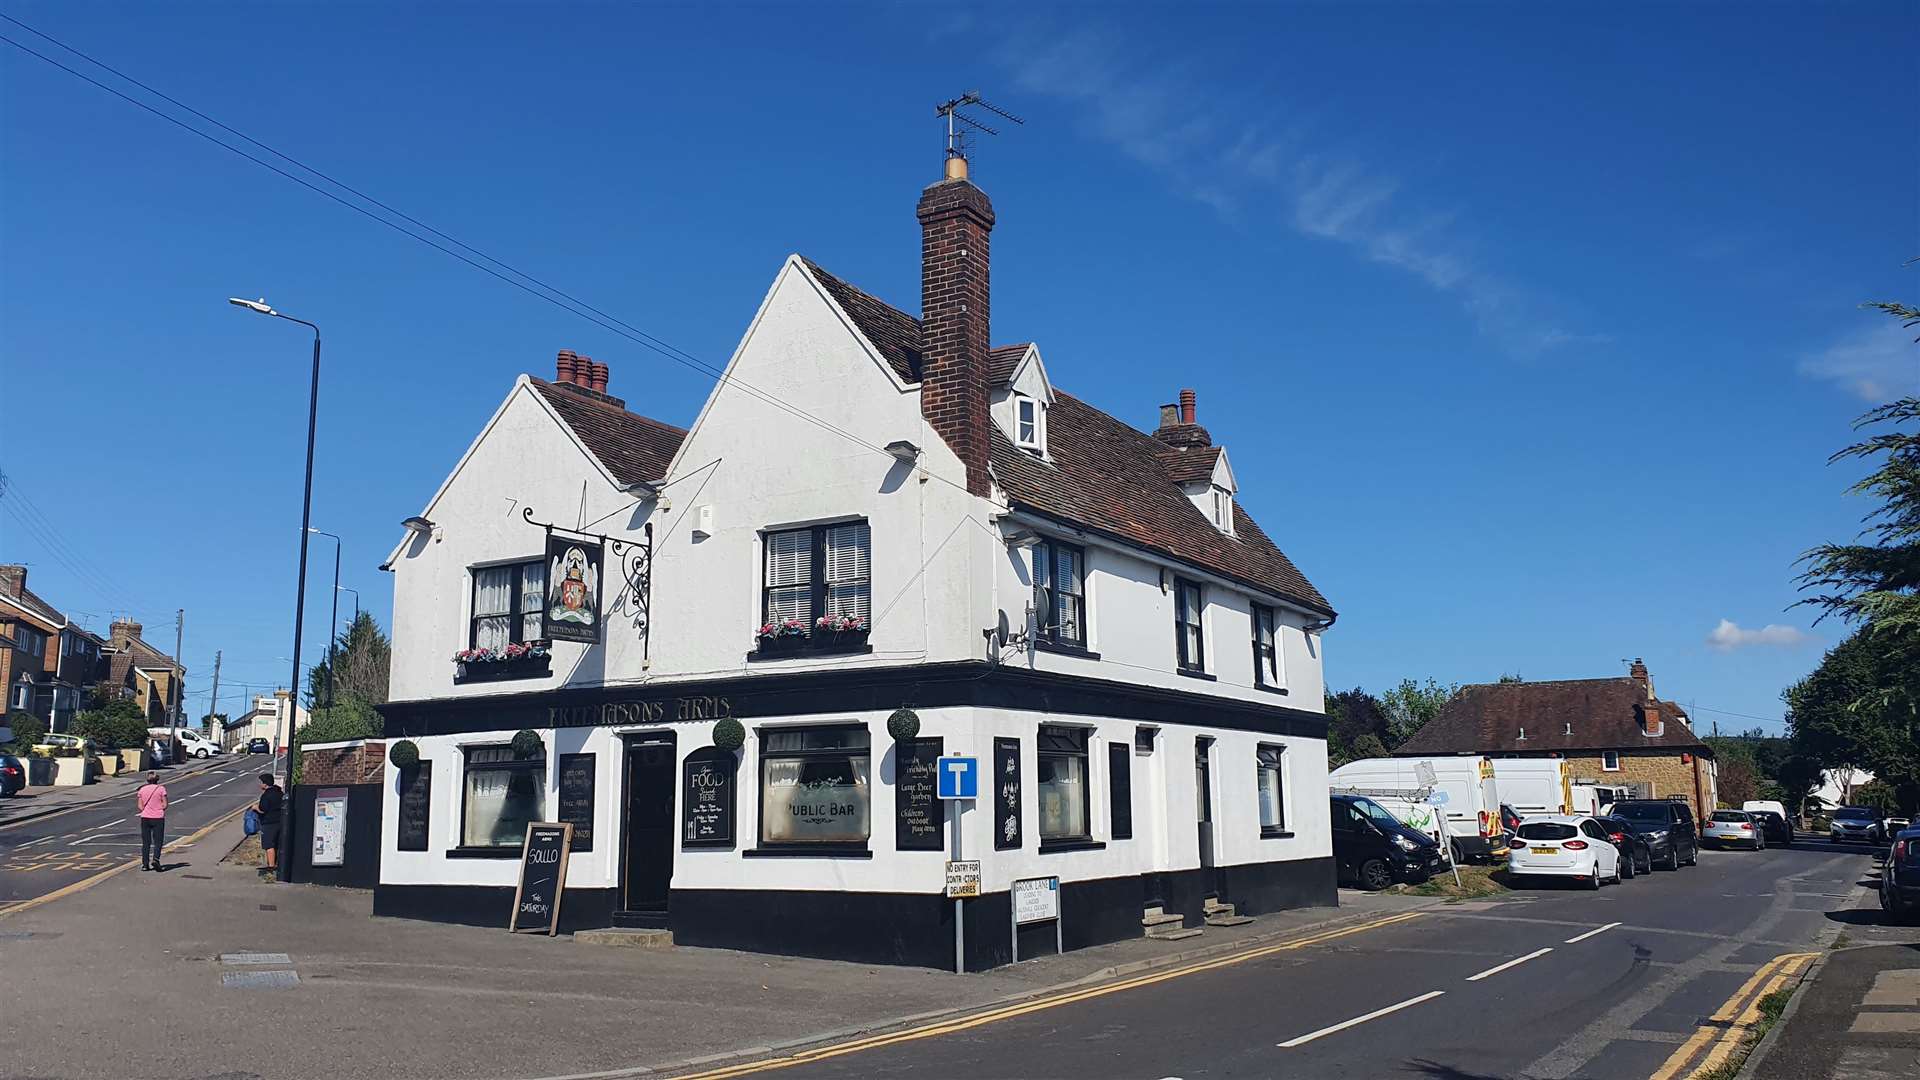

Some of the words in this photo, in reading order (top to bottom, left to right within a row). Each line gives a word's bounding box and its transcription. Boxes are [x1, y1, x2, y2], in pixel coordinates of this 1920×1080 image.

[549, 701, 664, 727] FREEMASONS
[678, 696, 731, 719] ARMS
[691, 773, 724, 788] FOOD
[946, 863, 954, 873] NO
[954, 863, 969, 873] ENTRY
[969, 863, 979, 872] FOR
[946, 875, 980, 884] CONTRCTORS
[1016, 880, 1035, 892] BROOK
[1035, 879, 1049, 890] LANE
